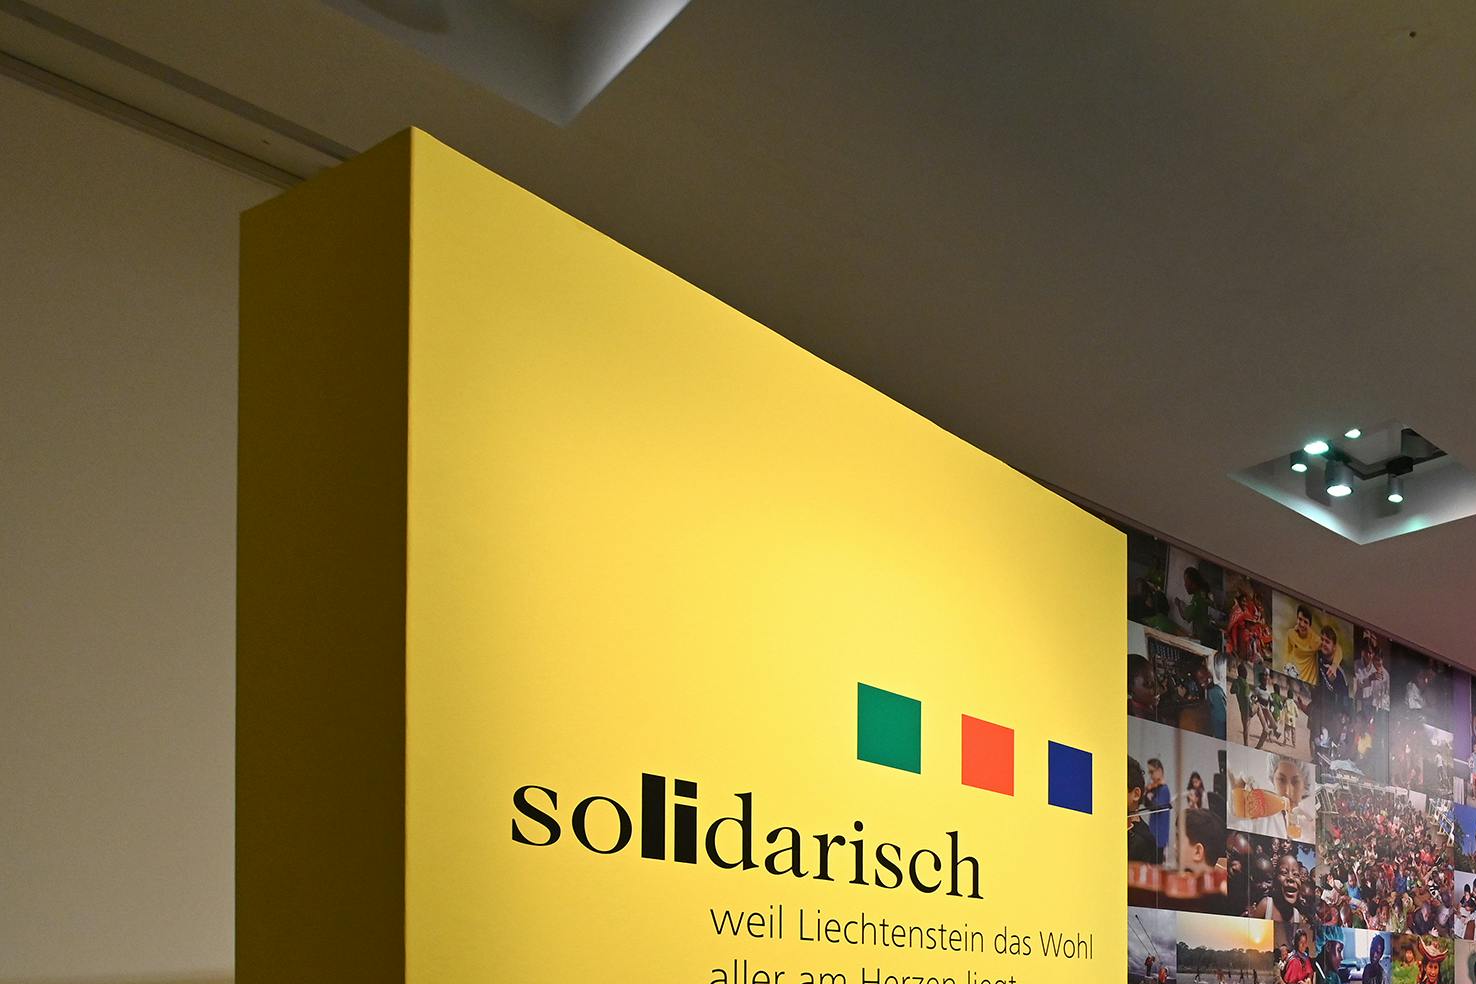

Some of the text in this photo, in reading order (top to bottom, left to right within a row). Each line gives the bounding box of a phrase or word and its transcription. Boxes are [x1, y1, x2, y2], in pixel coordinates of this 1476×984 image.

[511, 771, 985, 900] solidarisch
[710, 903, 1093, 960] weil Liechtenstein das Wohl
